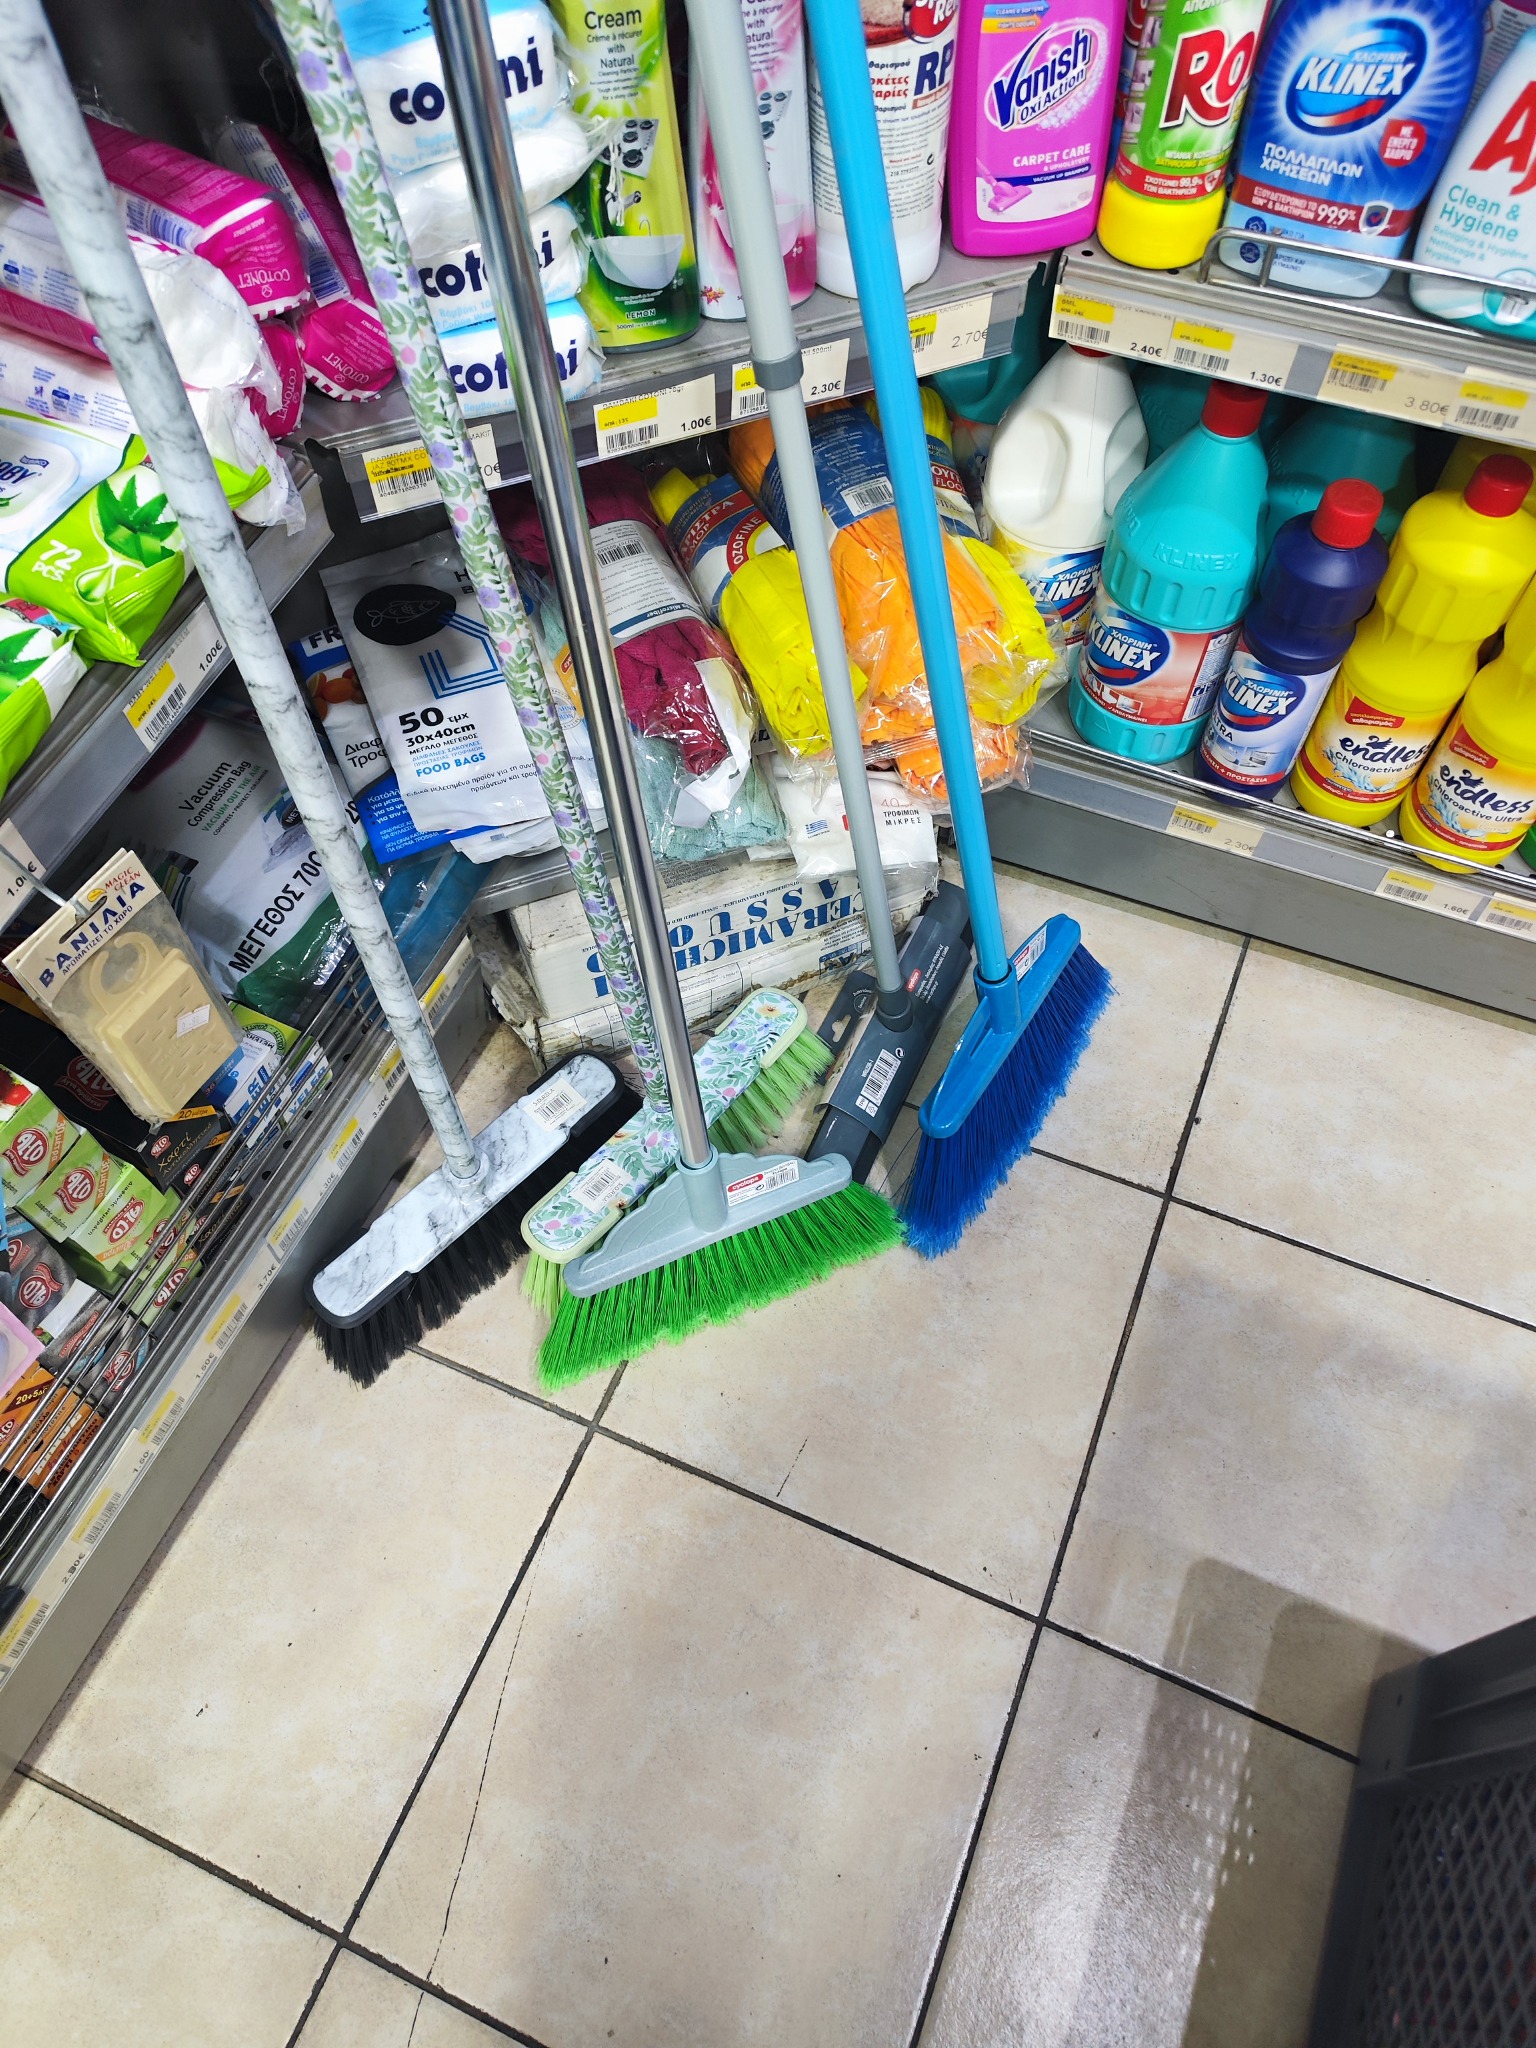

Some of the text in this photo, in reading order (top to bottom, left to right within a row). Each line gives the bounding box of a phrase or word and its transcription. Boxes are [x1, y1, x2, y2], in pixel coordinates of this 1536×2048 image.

[584, 9, 642, 30] Cream
[747, 19, 765, 29] with
[587, 33, 610, 43] Crème
[618, 30, 642, 40] récurer
[746, 28, 773, 43] atural
[607, 43, 625, 54] with
[1353, 51, 1409, 63] ΧΛΩΡΙΝΗ
[600, 54, 635, 69] Natural
[868, 59, 911, 70] θαρισμού
[389, 36, 543, 125] coni
[993, 26, 1092, 128] Vanish
[1160, 27, 1256, 128] RO
[1296, 56, 1416, 96] KLINEX
[872, 86, 910, 100] αρίες
[1021, 68, 1084, 122] Oxi Action
[1400, 126, 1414, 138] ΜΕ
[1013, 142, 1091, 168] CARPET CARE
[1384, 148, 1414, 160] ΧΛΩΡΙΟ
[1387, 138, 1418, 150] ΕΝΕΡΓΟ
[1260, 156, 1332, 187] ΧΡΗΣΕΩΝ
[1263, 142, 1363, 178] ΠΟΛΛΑΠΛΩΝ
[1033, 174, 1055, 183] VACUUM
[1064, 166, 1089, 178] SHAMPOO
[1144, 184, 1157, 193] ΤΩΝ
[1274, 204, 1315, 221] ΒΑΚΤΗΡΙΩΝ
[1317, 203, 1357, 226] 99.9%
[1448, 184, 1521, 222] Clean &
[1440, 203, 1519, 243] Hygiene
[1429, 236, 1476, 260] Nettoyage
[417, 230, 555, 298] coti
[239, 268, 291, 289] COTONET
[626, 308, 656, 319] LEMON
[616, 323, 634, 331] 500ml
[951, 329, 989, 349] 2.70€
[1130, 342, 1162, 358] 2.40€
[322, 352, 370, 384] COTONET
[1250, 371, 1283, 387] 1.30€
[276, 367, 297, 424] COTONET
[811, 380, 842, 396] 2.30€
[1404, 396, 1450, 417] 3.80€
[681, 415, 712, 432] 1.00€
[935, 477, 964, 492] FLOO
[690, 524, 710, 551] MOP
[732, 516, 762, 565] OZOFINE
[39, 539, 82, 571] 72
[1153, 542, 1240, 572] KLINEX
[1057, 562, 1101, 581] ΧΛΩΡΙΝΗ
[1026, 570, 1101, 602] KLINEX
[646, 603, 681, 618] Microfiber
[308, 625, 343, 650] FR
[1087, 616, 1161, 672] KLINEX
[1110, 629, 1153, 651] ΧΛΩΡΙΝΗ
[198, 640, 223, 672] 1.00€
[1224, 666, 1297, 716] KLINEX
[1245, 679, 1290, 697] ΧΛΩΡΙΝΗ
[398, 707, 470, 734] 50 τμχ
[344, 737, 383, 757] Διαφ
[405, 723, 476, 748] 30x40cm
[409, 732, 479, 756] ΜΕΓΑΛΟ ΜΕΓΕΘΟΣ
[412, 740, 481, 762] ΔΙΑΦΑΝΕΣ ΣΑΚΟΥΛΕΣ
[413, 745, 483, 768] ΠΡΟΣΤΑΣΙΑΣ ΤΡΟΦΙΜΩΝ
[1335, 751, 1403, 774] Chloroactive
[415, 752, 487, 778] FOOD BAGS
[178, 760, 233, 812] Vacuum
[430, 765, 518, 793] μελετημένο προϊόν για τη
[470, 774, 520, 793] προϊόντων και
[1226, 771, 1268, 783] ΠΡΟΣΤΑΣΙΑ
[187, 759, 252, 828] Compression Bag
[201, 765, 262, 833] VACUUM OUT THE AIR
[367, 789, 401, 803] Κατάλλ
[1434, 778, 1523, 823] Chloroactive Ultra
[1440, 764, 1535, 814] endless
[212, 811, 233, 836] COMPRESS
[234, 793, 250, 813] PROTECT
[371, 802, 382, 810] για
[374, 809, 385, 817] για
[883, 809, 920, 818] ΤΡΟΦΙΜΩΝ
[376, 816, 388, 824] για
[885, 817, 921, 826] ΜΙΚΡΕΣ
[1223, 838, 1255, 853] 2.30€
[7, 861, 38, 897] 1.0€
[105, 866, 134, 890] MAGIC
[114, 870, 141, 892] CLEAN
[1443, 903, 1470, 915] 1.60€
[38, 881, 145, 988] ΒΑΝΙΛΙΑ
[228, 883, 305, 974] ΜΕΓΕΘΟΣ
[672, 891, 865, 972] CERAMICH
[62, 905, 133, 976] ΑΡΩΜΑΤΙΖΕΙ ΤΟ ΧΩΡΟ
[908, 971, 921, 990] cyclops
[178, 1109, 193, 1120] 20
[372, 1095, 389, 1119] 3.20€
[157, 1132, 192, 1172] Χαρτί
[732, 1176, 759, 1190] cyclops
[256, 1263, 277, 1292] 3.70€
